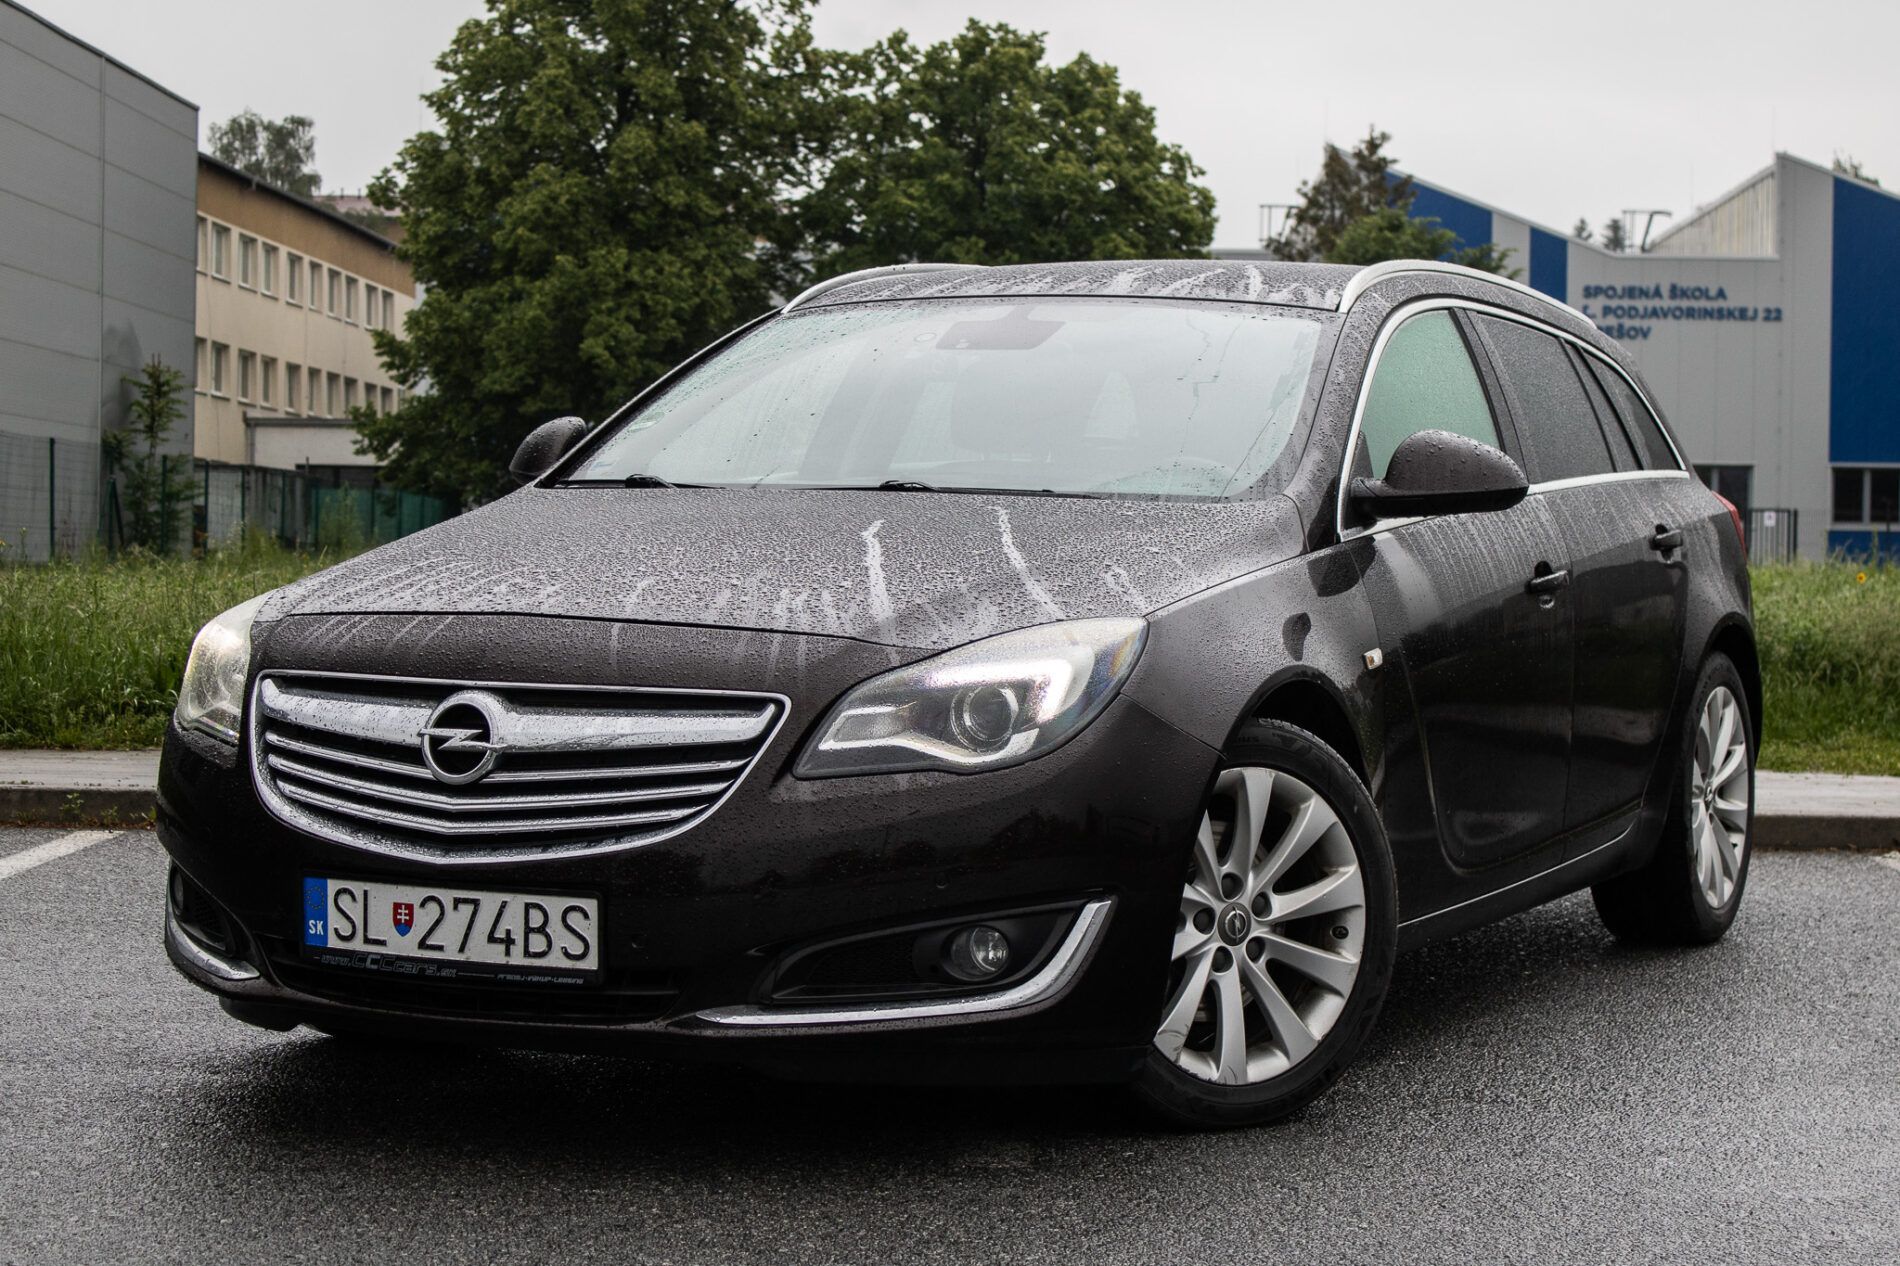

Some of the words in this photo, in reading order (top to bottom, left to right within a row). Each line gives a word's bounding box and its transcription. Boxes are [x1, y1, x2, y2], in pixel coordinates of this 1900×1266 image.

[1583, 283, 1664, 300] SPOJENÁ
[1668, 282, 1728, 301] ŠKOLA
[1602, 304, 1759, 321] PODJAVORINSKEJ
[1762, 307, 1783, 322] 22
[308, 919, 324, 936] SK
[333, 887, 388, 947] SL
[417, 895, 591, 961] 274BS
